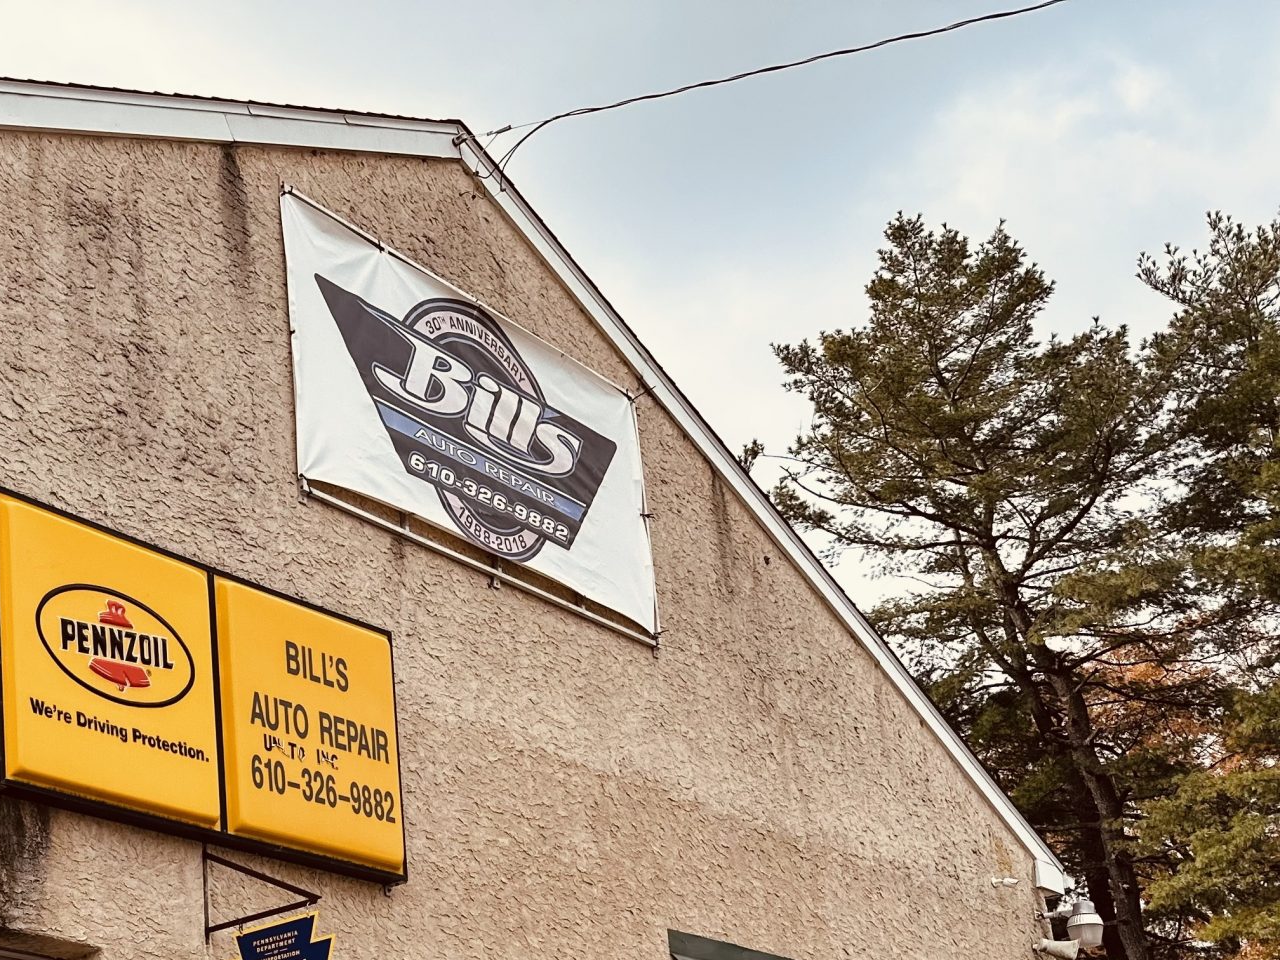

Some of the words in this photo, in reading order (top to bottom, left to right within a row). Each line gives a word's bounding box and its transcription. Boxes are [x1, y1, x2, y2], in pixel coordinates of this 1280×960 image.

[449, 315, 526, 383] ANNIVERSARY
[372, 324, 583, 477] Bills
[408, 451, 570, 543] 610-326-9882
[414, 427, 477, 466] AUTO
[484, 461, 556, 506] REPAIR
[458, 505, 528, 552] 1988-2018
[59, 617, 175, 670] PENNZOIL
[285, 639, 349, 692] BILL'S
[29, 697, 72, 724] We're
[76, 710, 128, 743] Driving
[132, 727, 210, 763] Protection.
[250, 691, 309, 740] AUTO
[318, 710, 390, 765] REPAIR
[251, 753, 396, 824] 610-326-9882
[252, 930, 298, 947] PENNSYLVANIA
[256, 937, 296, 953] DEPARTMENT
